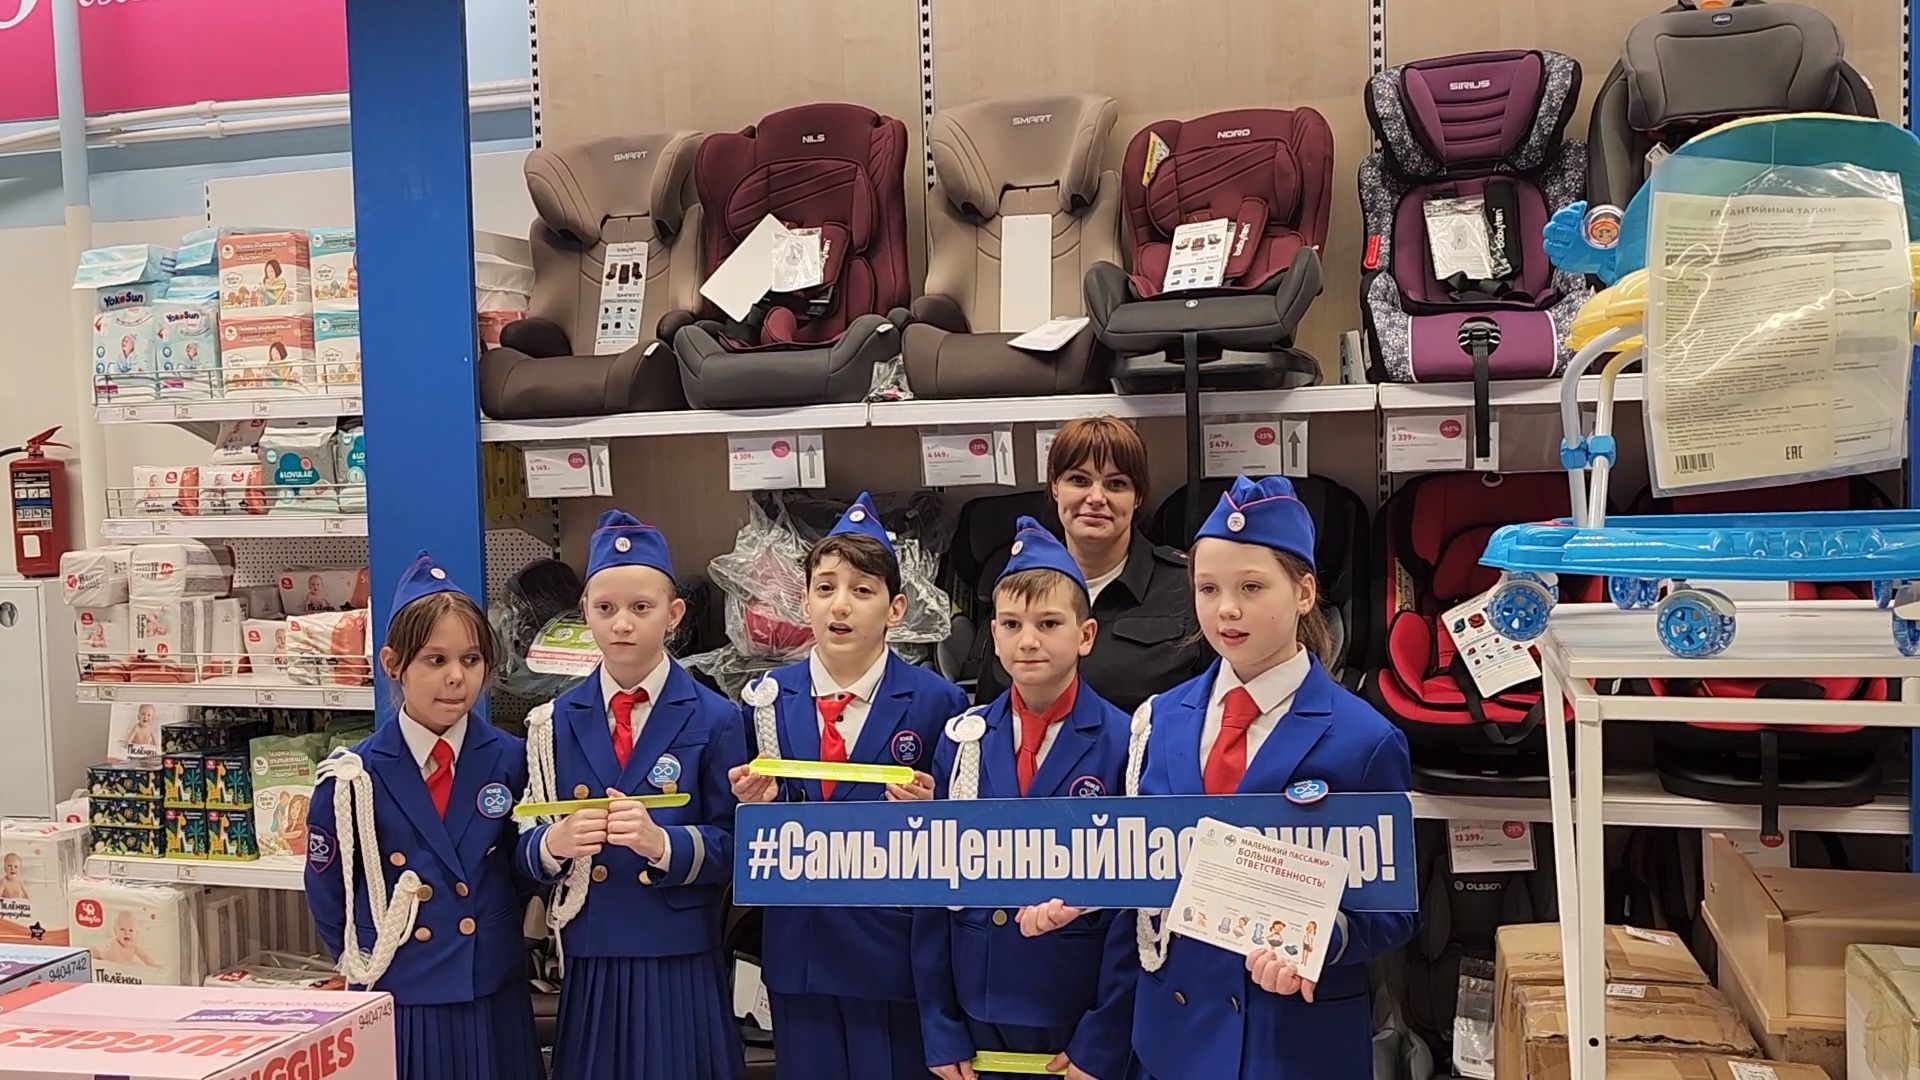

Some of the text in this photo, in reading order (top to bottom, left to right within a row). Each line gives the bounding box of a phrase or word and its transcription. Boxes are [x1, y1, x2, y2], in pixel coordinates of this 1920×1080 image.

[1449, 78, 1491, 91] SIRIUS
[1012, 114, 1053, 126] SMART
[802, 134, 826, 144] NILS
[1217, 128, 1251, 139] NORD
[613, 150, 649, 162] SMART
[1710, 206, 1794, 217] ГААНТИЙНЫЙ
[1237, 847, 1284, 867] БОЛЬШАЯ
[1240, 838, 1288, 858] МАЛЕНЬКИЙ
[1288, 850, 1330, 868] ПАССАЖИР
[1235, 857, 1327, 889] ОТВЕТСТВЕННОСТЬ!
[48, 957, 88, 983] 9404742
[96, 968, 142, 985] Пелёнки
[358, 1002, 392, 1030] 9404743
